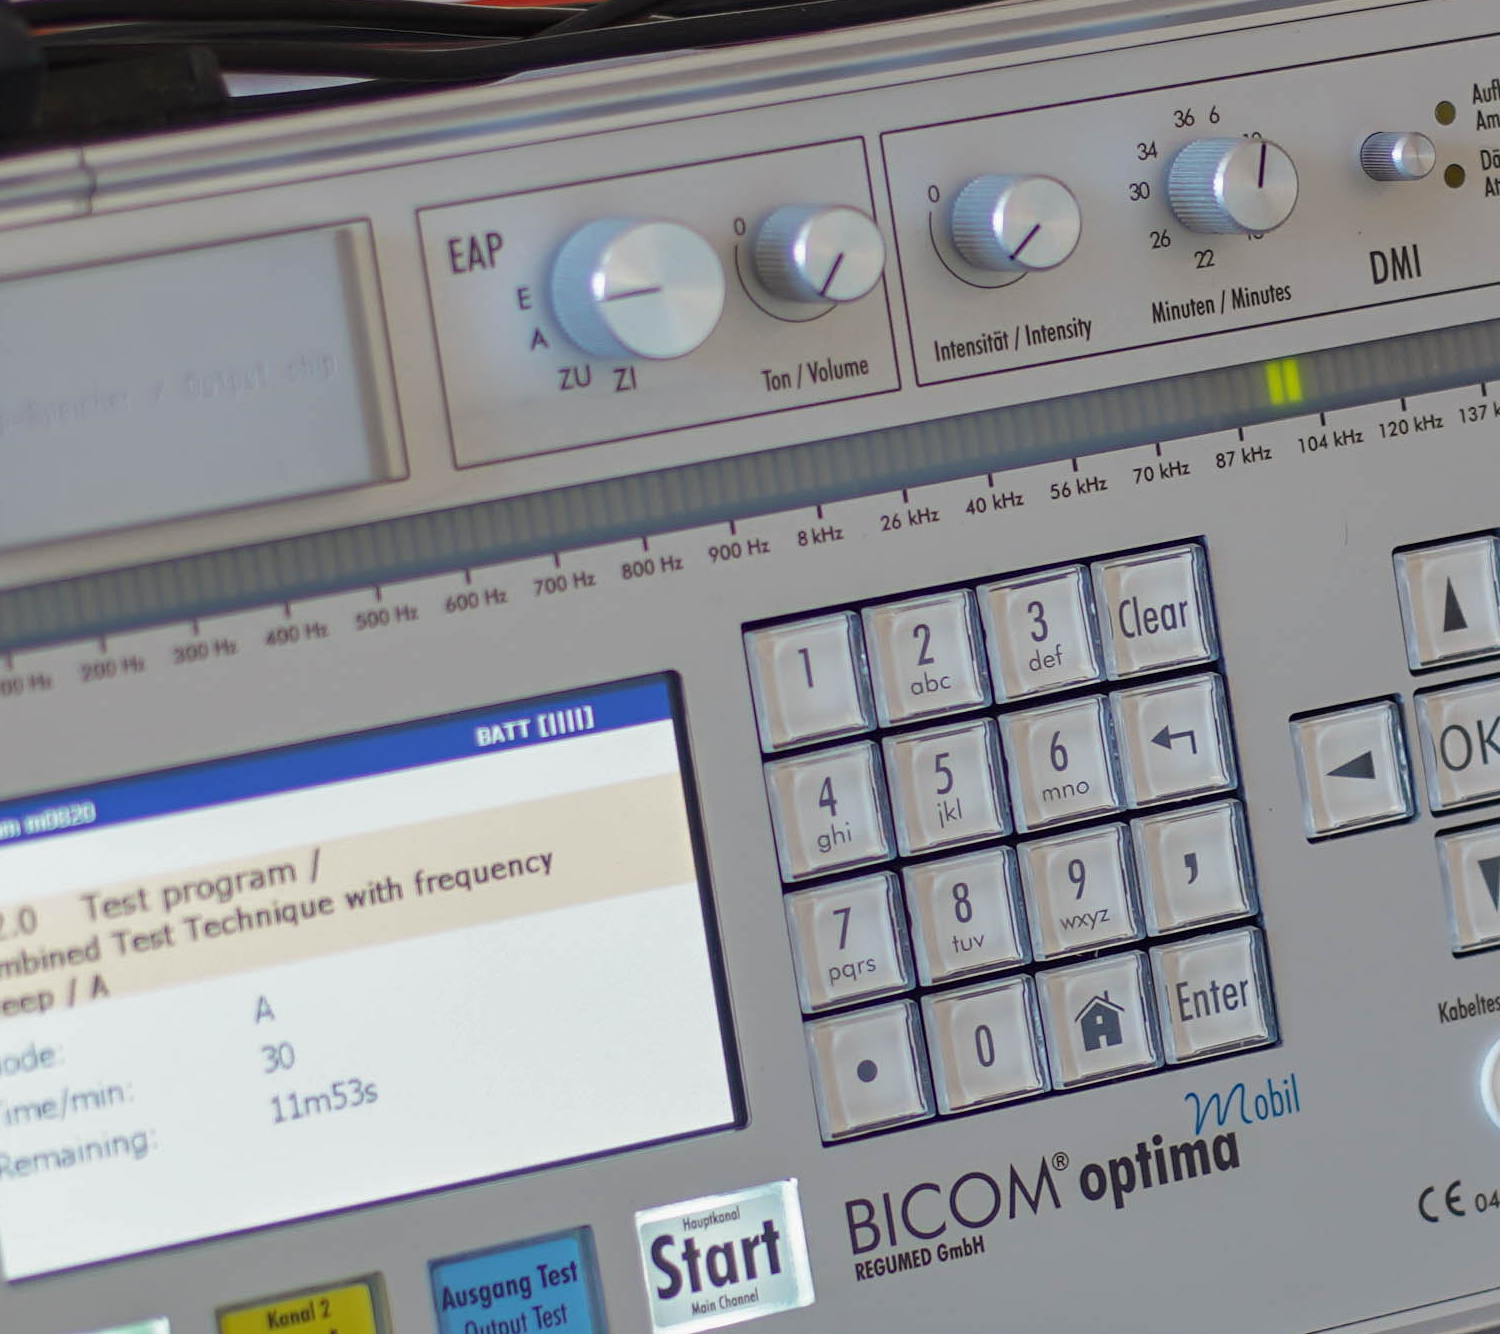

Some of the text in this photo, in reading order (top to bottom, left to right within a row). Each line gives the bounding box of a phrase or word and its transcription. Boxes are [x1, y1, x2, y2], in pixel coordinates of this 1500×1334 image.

[1173, 109, 1195, 127] 36
[1209, 105, 1220, 124] 6
[1138, 142, 1158, 160] 34
[927, 185, 939, 203] 0
[1130, 182, 1150, 200] 30
[734, 218, 746, 235] 0
[1149, 230, 1171, 250] 26
[447, 233, 503, 273] EAP
[1194, 250, 1214, 268] 22
[1370, 245, 1422, 285] DMI
[517, 287, 531, 310] E
[1152, 283, 1292, 324] Minuten Minutes
[529, 328, 549, 351] A
[934, 318, 1092, 362] Intensität Intensity
[558, 365, 591, 390] ZU
[613, 367, 638, 392] ZI
[762, 356, 869, 392] Ton Volume
[1379, 413, 1444, 438] 120 kHz
[1459, 406, 1491, 424] 137
[1298, 428, 1364, 454] 104 kHz
[1215, 444, 1273, 468] 87 kHz
[1133, 461, 1190, 484] 70 kHz
[1050, 476, 1108, 499] 56 kHz
[965, 492, 1024, 515] 40 kHz
[880, 508, 940, 531] 26 kHz
[797, 525, 844, 546] 8 kHz
[708, 539, 771, 563] 900 Hz
[621, 555, 684, 579] 800 Hz
[533, 571, 596, 596] 700 Hz
[445, 588, 508, 614] 600 Hz
[355, 604, 419, 630] 500 Hz
[1027, 601, 1049, 642] 3
[1120, 597, 1188, 638] Clear
[266, 622, 329, 646] 400 Hz
[913, 623, 934, 666] 2
[173, 639, 237, 664] 300 Hz
[1029, 645, 1063, 672] def
[81, 656, 145, 681] 200 Hz
[798, 647, 815, 689] 1
[911, 671, 951, 695] abc
[476, 718, 531, 747] BATT
[1050, 730, 1069, 771] 6
[935, 752, 954, 794] 5
[818, 776, 837, 818] 4
[1043, 778, 1089, 802] mno
[936, 800, 963, 828] jkl
[817, 823, 853, 852] ghi
[81, 889, 148, 923] Test
[164, 859, 297, 914] program
[1068, 858, 1087, 900] 9
[112, 924, 174, 957] Test
[184, 889, 336, 946] Technique
[345, 878, 405, 909] with
[415, 850, 555, 900] frequency
[952, 881, 973, 923] 8
[832, 907, 851, 950] 7
[1059, 905, 1110, 933] wxyz
[951, 931, 985, 954] tuv
[828, 958, 877, 985] pqrs
[90, 974, 110, 1000] A
[1177, 978, 1249, 1022] Enter
[254, 995, 276, 1025] A
[262, 1044, 296, 1073] 30
[975, 1024, 996, 1067] 0
[272, 1080, 379, 1125] 11m53s
[1185, 1073, 1300, 1134] Mobil
[1079, 1132, 1240, 1209] optima
[683, 1206, 740, 1231] Hauptkanal
[651, 1219, 781, 1300] Start
[855, 1234, 985, 1282] REGUMED GmbH
[442, 1261, 578, 1313] Ausgang Test
[267, 1299, 331, 1332] Kanal 2
[692, 1288, 760, 1316] Main Channel
[538, 1303, 568, 1331] Test
